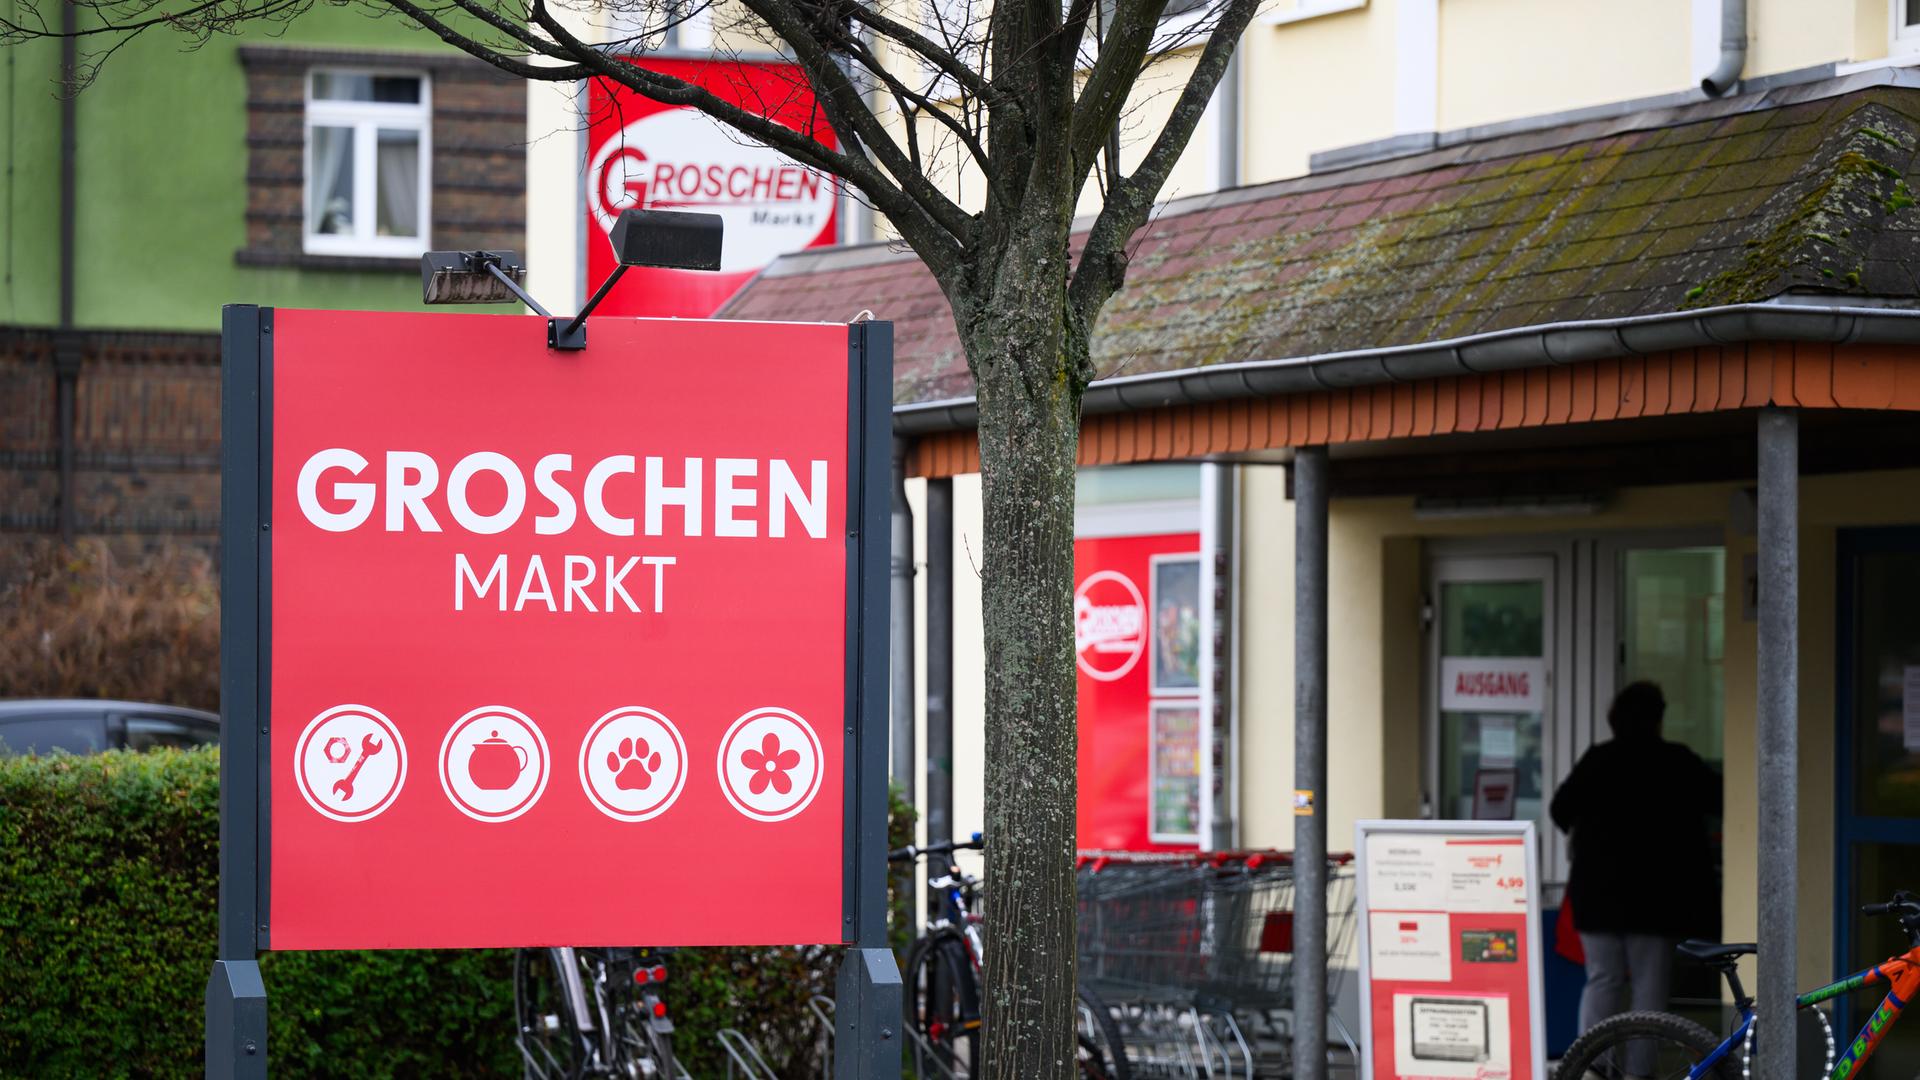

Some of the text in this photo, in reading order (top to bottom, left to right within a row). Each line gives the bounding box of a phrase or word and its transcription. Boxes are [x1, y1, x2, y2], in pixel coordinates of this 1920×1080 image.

[598, 146, 820, 217] GROSCHEN
[754, 209, 816, 226] Markt
[297, 447, 828, 539] GROSCHEN
[454, 553, 677, 613] MARKT
[1455, 671, 1530, 697] AUSGANG
[1496, 876, 1524, 889] 4,99
